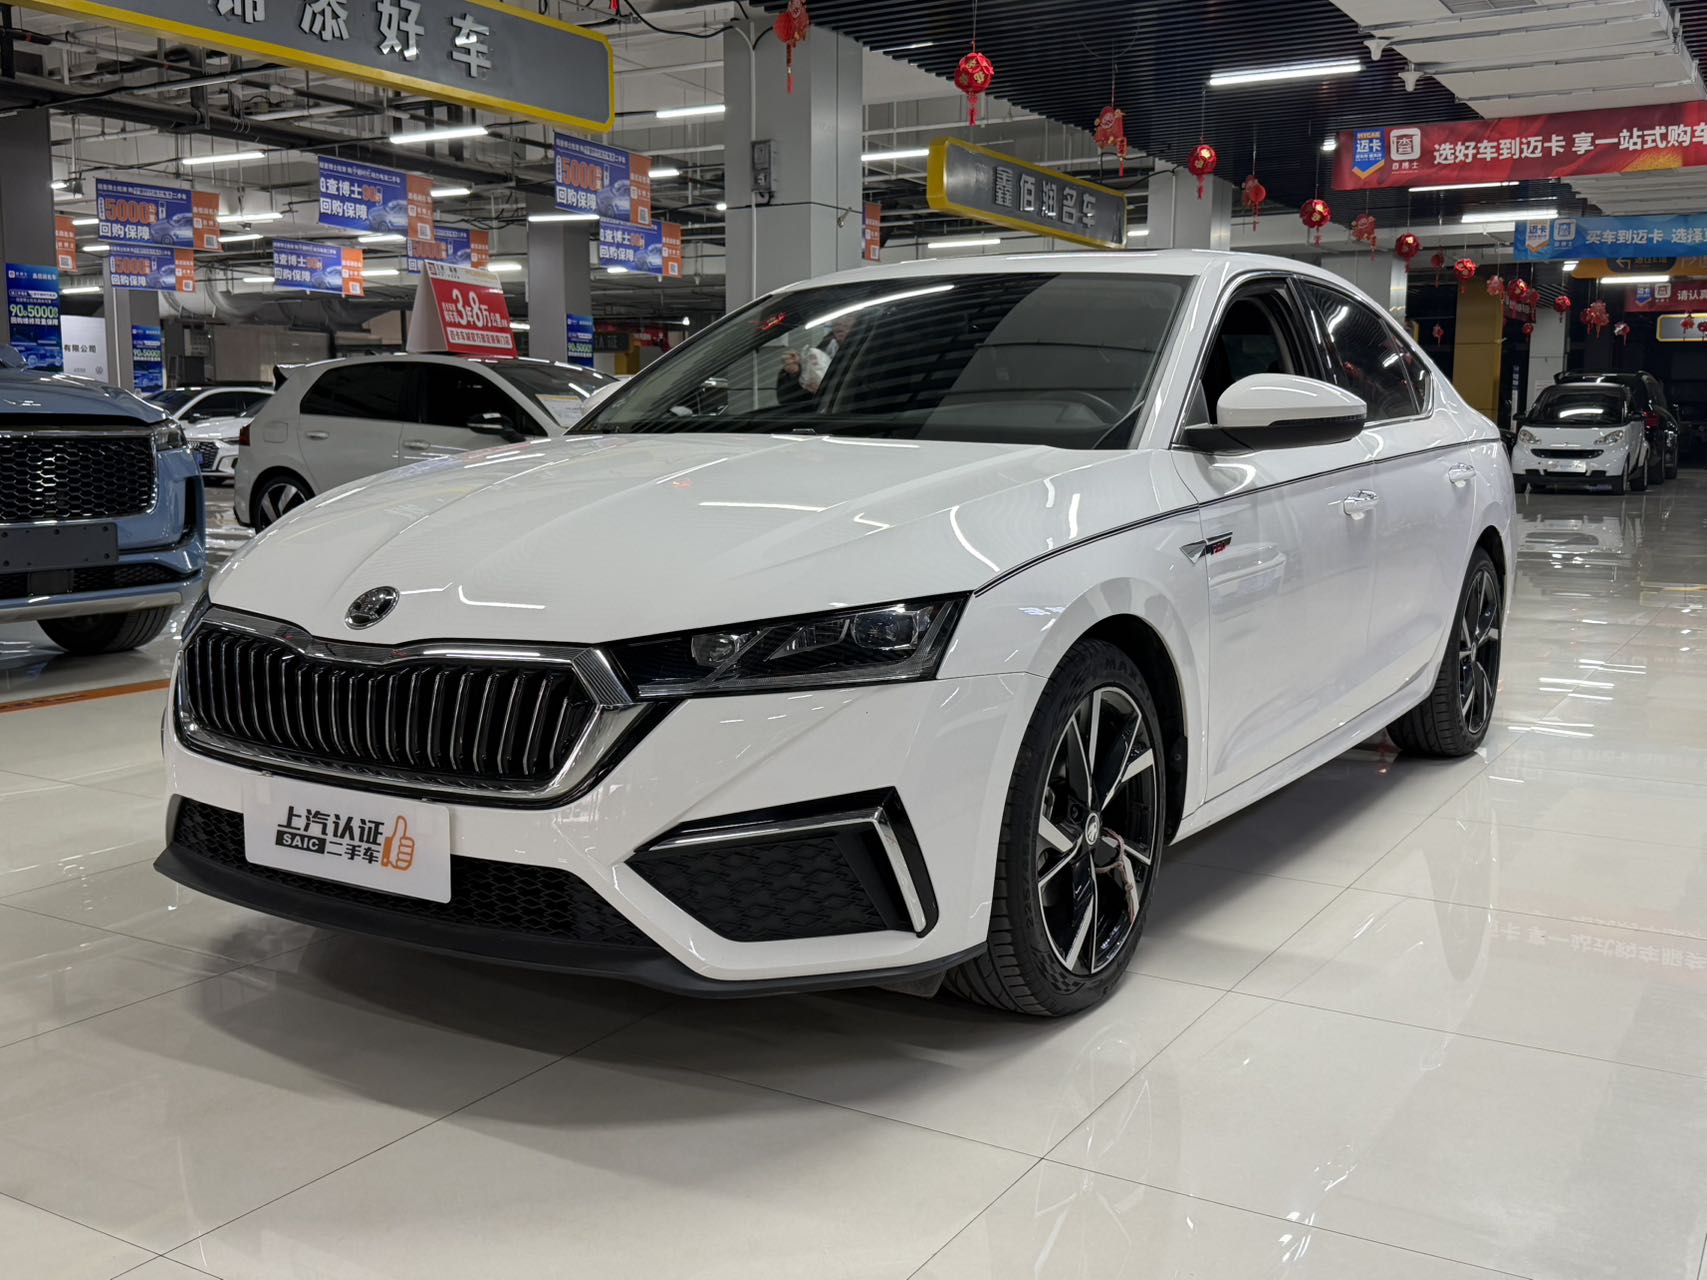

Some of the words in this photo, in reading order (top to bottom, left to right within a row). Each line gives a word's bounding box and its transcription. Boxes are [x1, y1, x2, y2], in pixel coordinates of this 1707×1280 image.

[1356, 139, 1382, 152] 迈卡
[1433, 134, 1566, 165] 选好车到迈卡
[556, 186, 598, 211] 回购保障
[320, 198, 368, 221] 回购保障
[99, 222, 150, 241] 回购保障
[1585, 229, 1664, 245] 买车到迈卡
[600, 245, 634, 262] 回购保障
[64, 344, 96, 353] 有限公司
[277, 805, 385, 846] 上汽认证
[282, 833, 319, 851] SAIC
[326, 840, 381, 864] 二手车
